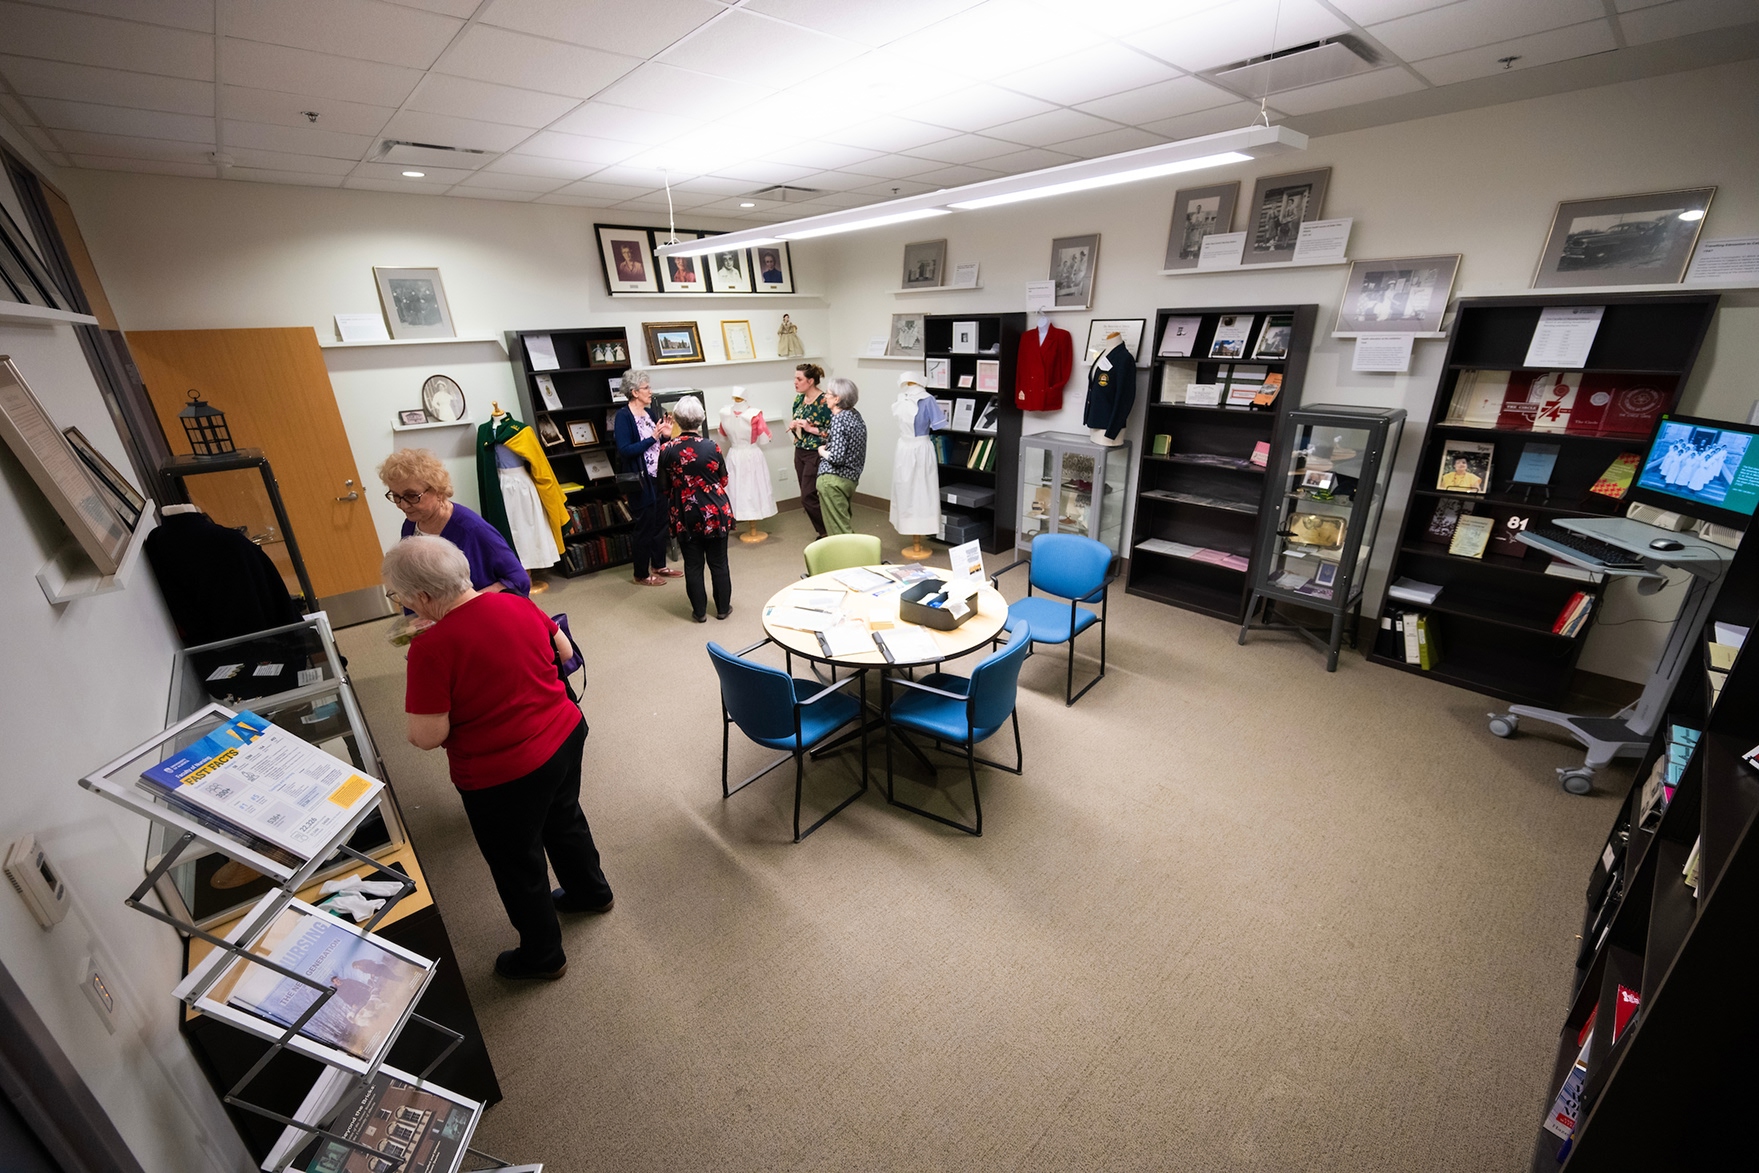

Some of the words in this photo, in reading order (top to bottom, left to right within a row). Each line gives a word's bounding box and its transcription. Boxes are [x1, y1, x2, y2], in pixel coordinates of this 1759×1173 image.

[1507, 516, 1529, 531] 81
[175, 768, 192, 779] Faculty
[195, 756, 213, 767] Nursing
[184, 768, 209, 785] FAST
[208, 749, 239, 770] FACTS
[280, 921, 327, 969] NURSING
[280, 990, 294, 1006] THE
[306, 938, 341, 976] GENERATION
[355, 1105, 363, 1116] the
